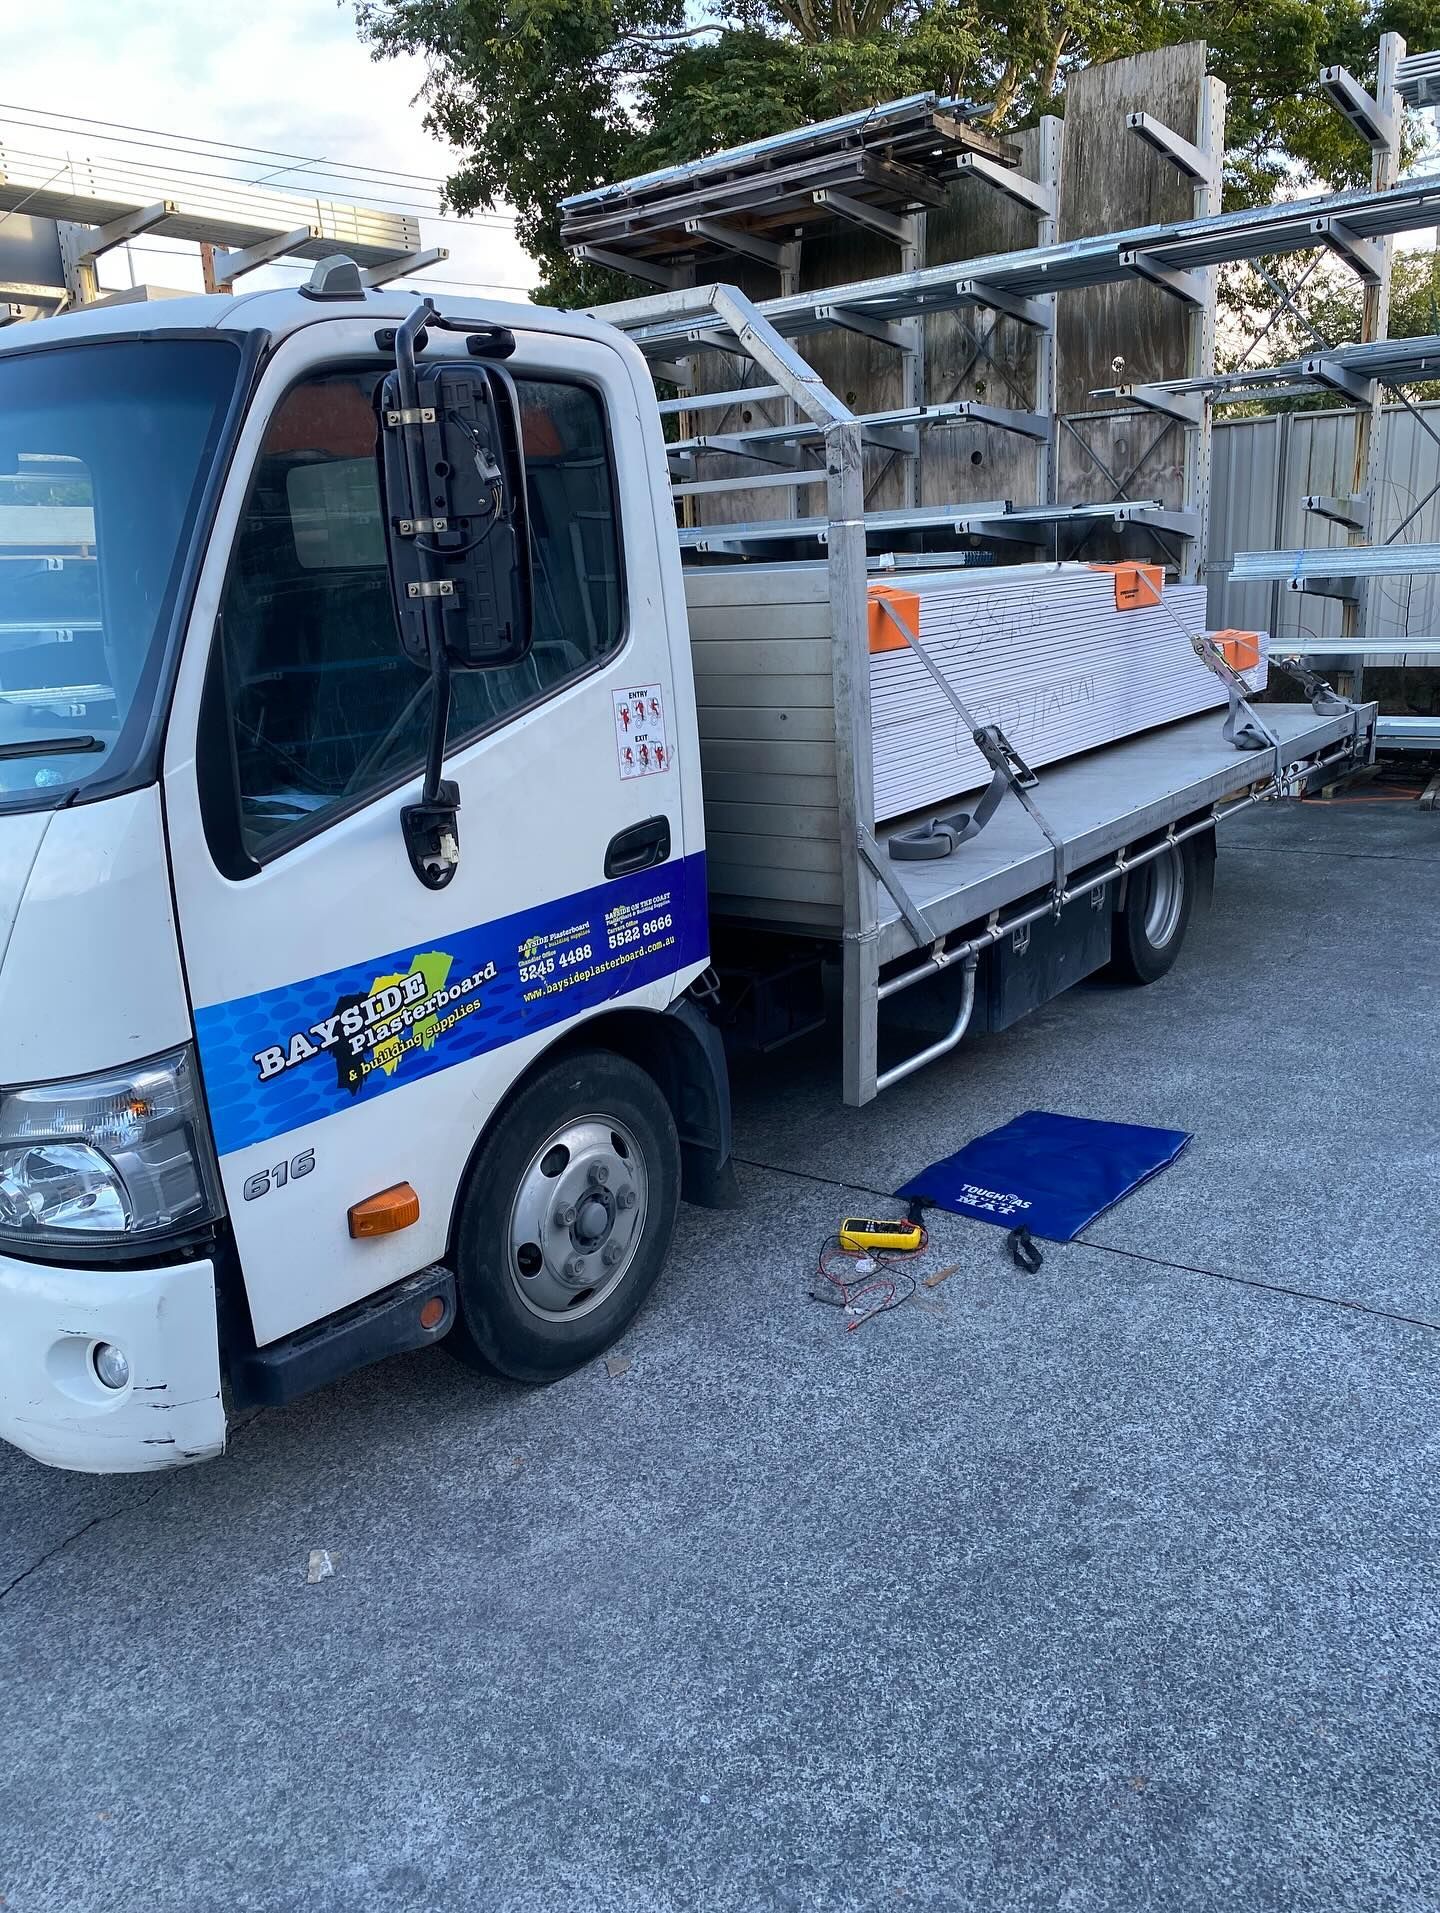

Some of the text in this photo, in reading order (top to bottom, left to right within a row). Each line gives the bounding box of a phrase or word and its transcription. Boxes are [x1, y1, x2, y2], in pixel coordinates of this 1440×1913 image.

[628, 690, 648, 699] ENTRY
[635, 734, 648, 742] EXIT
[604, 892, 671, 920] BAYSIDE ON THE COAST
[517, 920, 590, 953] BAYSIDE Plasterboard
[608, 913, 673, 949] 5522 8666
[517, 950, 556, 967] Chandler Office
[519, 944, 593, 983] 3245 4488
[523, 936, 675, 1002] www.baysideplasterboard.com.au
[253, 972, 427, 1080] BAYSIDE
[348, 961, 498, 1056] Plasterboard
[348, 998, 482, 1081] & building supplies
[243, 1147, 316, 1202] 616
[955, 1195, 1016, 1215] MAT
